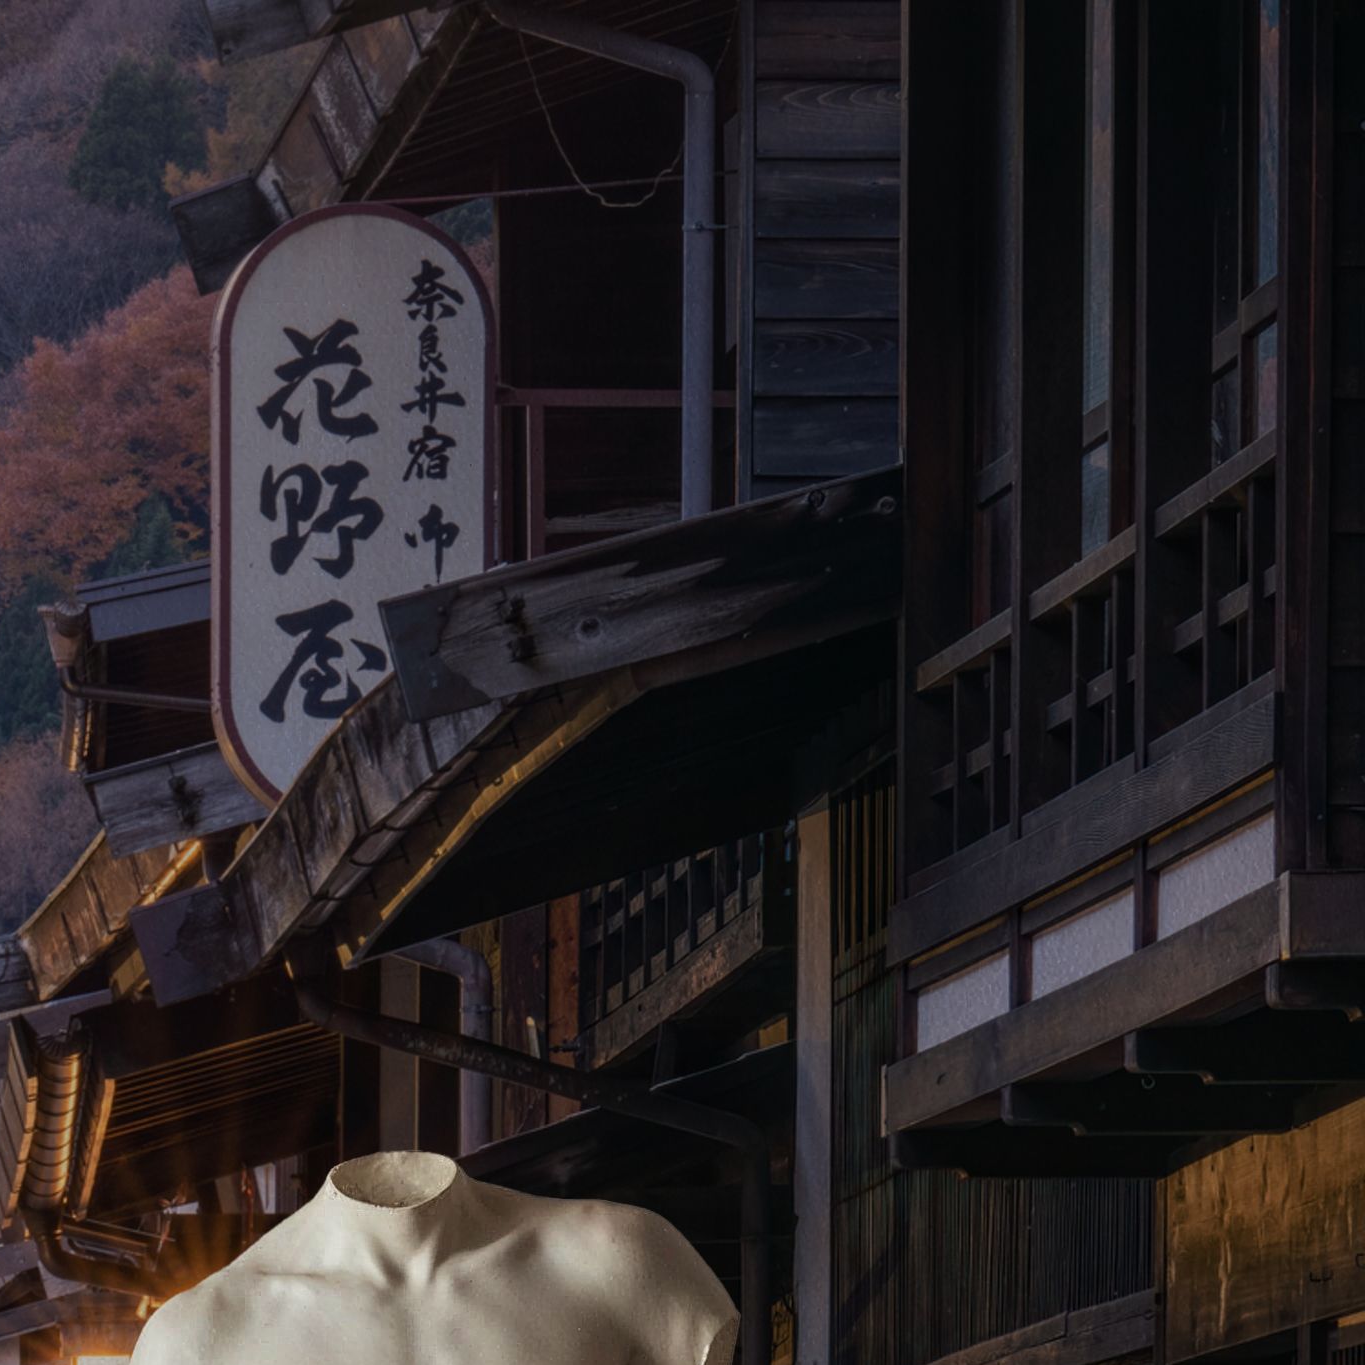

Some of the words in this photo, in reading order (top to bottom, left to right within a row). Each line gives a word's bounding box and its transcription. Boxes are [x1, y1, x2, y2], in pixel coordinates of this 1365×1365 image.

[256, 319, 387, 724] 花野屋
[400, 258, 466, 483] 奈良井宿
